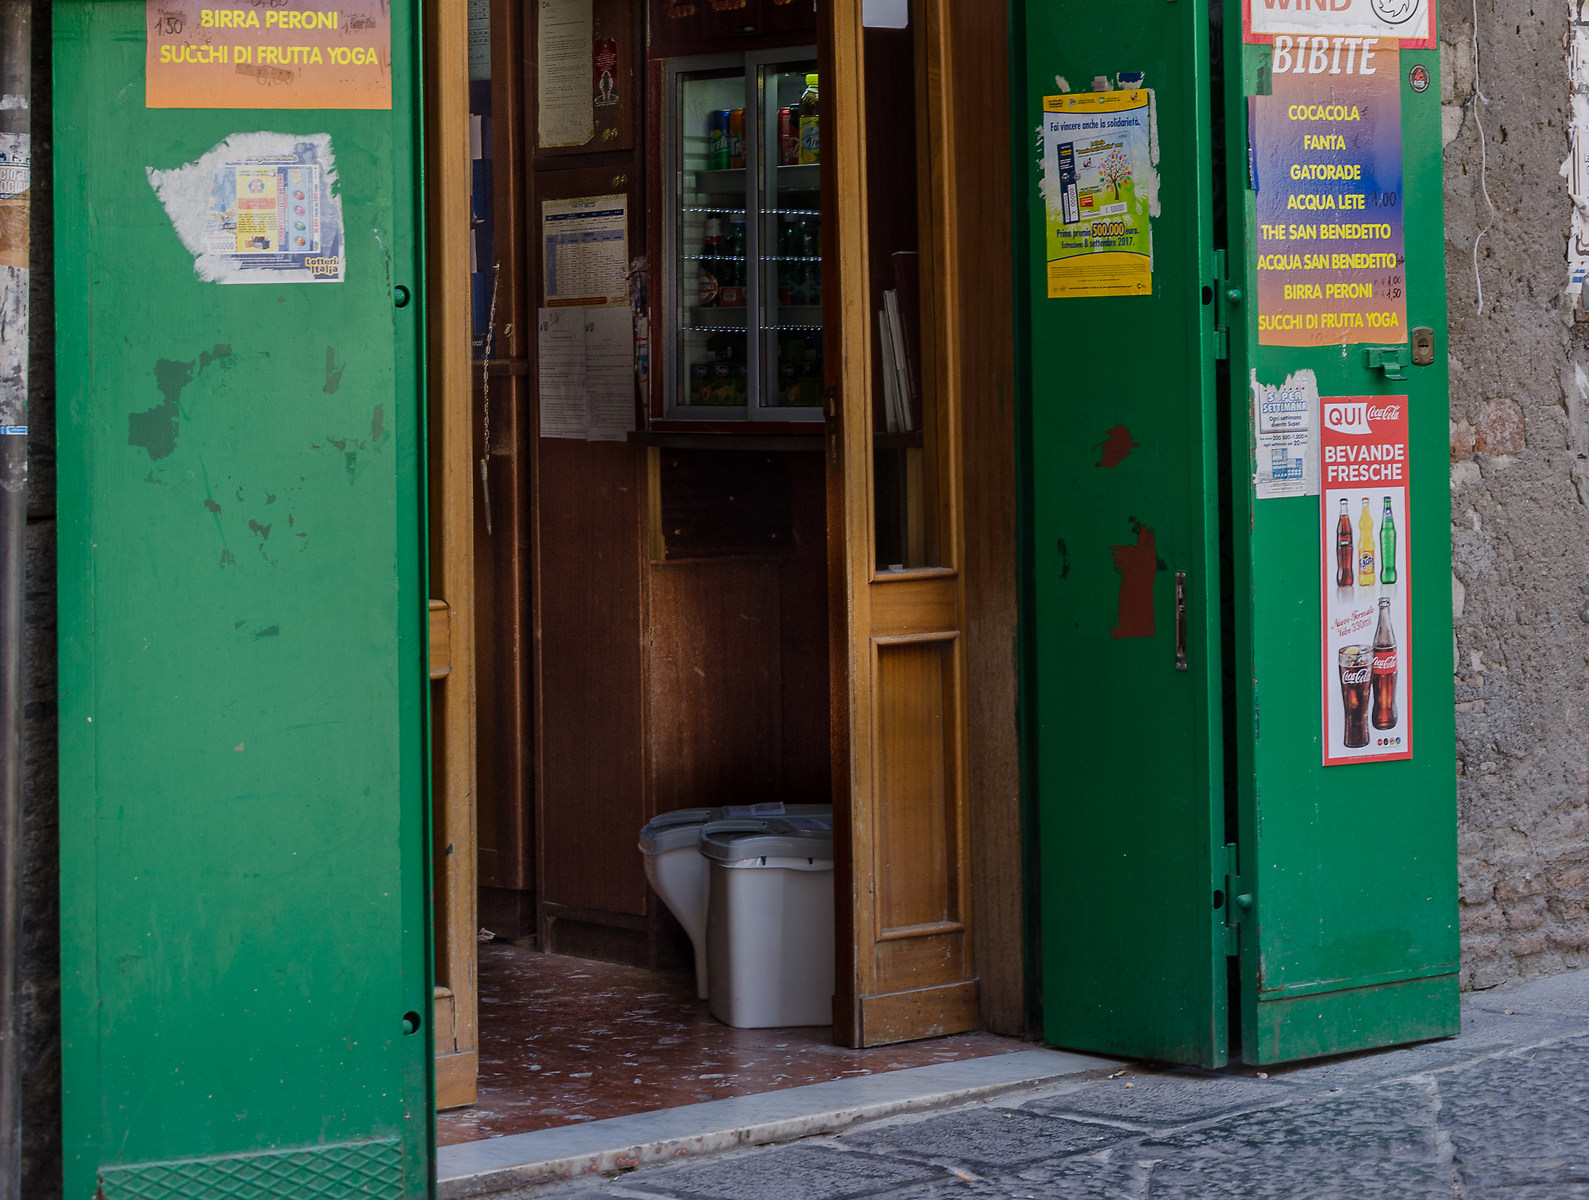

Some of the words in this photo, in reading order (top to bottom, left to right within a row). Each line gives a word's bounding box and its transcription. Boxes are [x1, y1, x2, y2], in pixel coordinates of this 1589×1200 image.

[201, 10, 260, 29] BIRRA
[265, 10, 338, 30] PERONI
[159, 45, 228, 64] SUCCHI
[234, 46, 253, 64] DI
[257, 46, 323, 65] FRUTTA
[327, 47, 379, 66] YOGA
[1272, 35, 1378, 75] BIBITE
[1288, 104, 1360, 121] COCACOLA
[1050, 122, 1059, 132] Fai
[1060, 121, 1081, 131] vincere
[1082, 118, 1099, 129] anche
[1099, 118, 1106, 128] la
[1304, 135, 1346, 150] FANTA
[1290, 164, 1361, 180] GATORADE
[1287, 194, 1335, 210] ACQUA
[1338, 194, 1365, 210] LETE
[1092, 222, 1125, 237] 500.000
[1261, 224, 1287, 239] THE
[1289, 224, 1317, 240] SAN
[1320, 224, 1391, 239] BENEDETTO
[1090, 238, 1116, 247] settembre
[1257, 254, 1302, 270] ACQUA
[1304, 253, 1329, 269] SAN
[1332, 253, 1397, 269] BENEDETTO
[1284, 284, 1322, 299] BIRRA
[1326, 283, 1372, 299] PERONI
[1258, 315, 1303, 330] SUCCHI
[1306, 314, 1318, 329] DI
[1321, 313, 1364, 328] FRUTTA
[1366, 312, 1399, 328] YOGA
[1267, 391, 1302, 402] SPER
[1262, 401, 1308, 413] SETTIMANA
[1329, 408, 1361, 426] QUI
[1325, 444, 1404, 462] BEVANDE
[1328, 464, 1402, 482] FRESCHE
